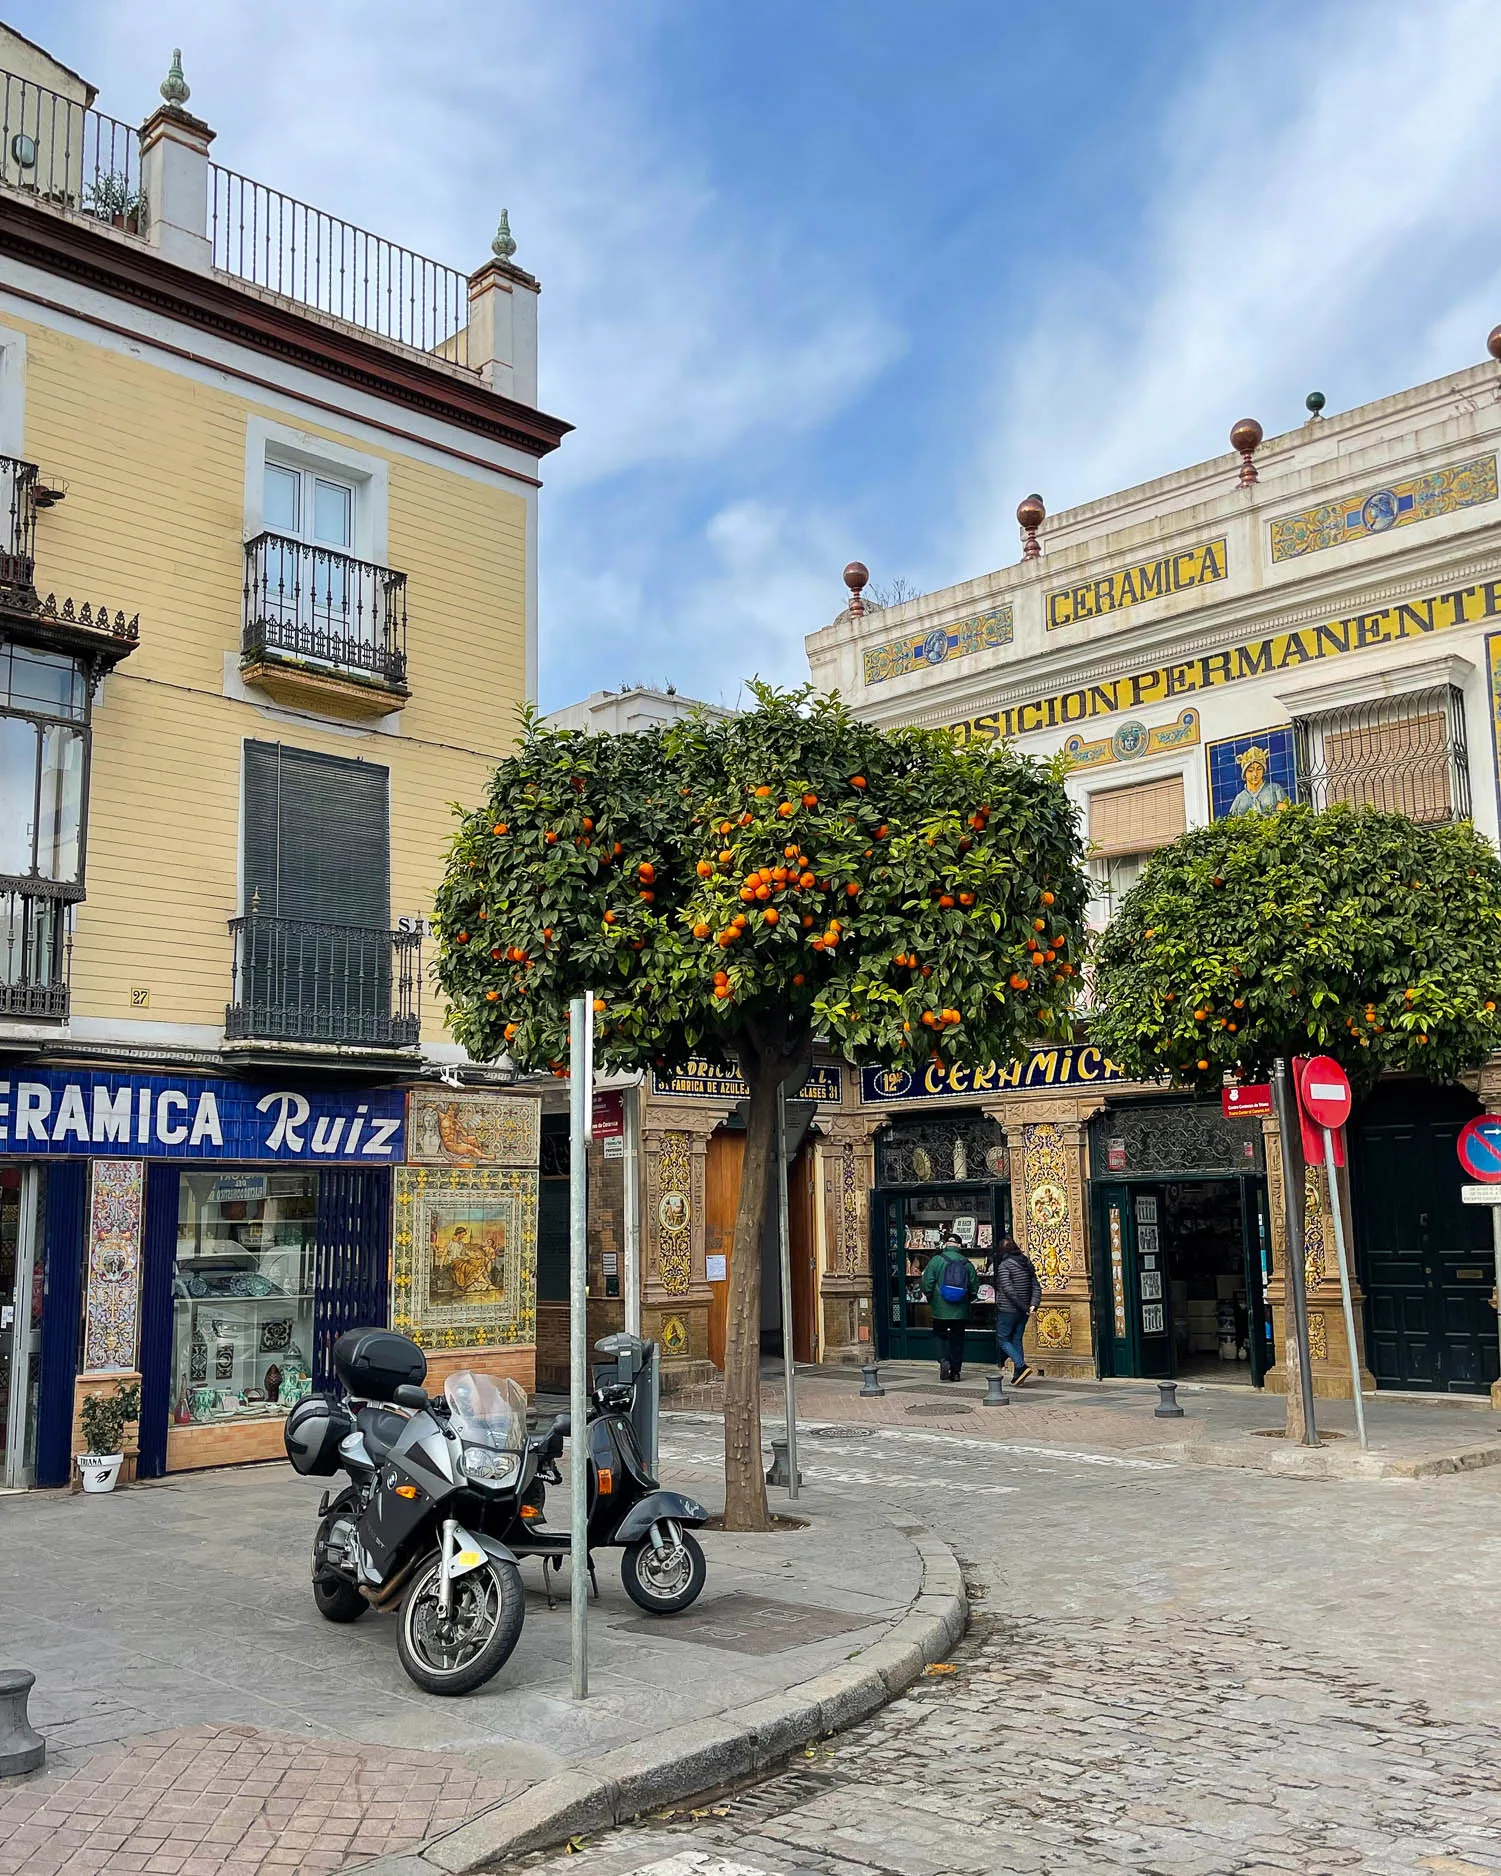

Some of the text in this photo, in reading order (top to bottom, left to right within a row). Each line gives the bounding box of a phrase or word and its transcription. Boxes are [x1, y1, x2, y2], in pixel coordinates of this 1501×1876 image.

[1050, 546, 1222, 626] CERAMICA
[935, 580, 1501, 748] OSICION PERMANENTE
[133, 991, 148, 1004] 27
[672, 1079, 704, 1092] FABRICA
[707, 1081, 718, 1093] DE
[256, 1091, 402, 1154] Ruiz
